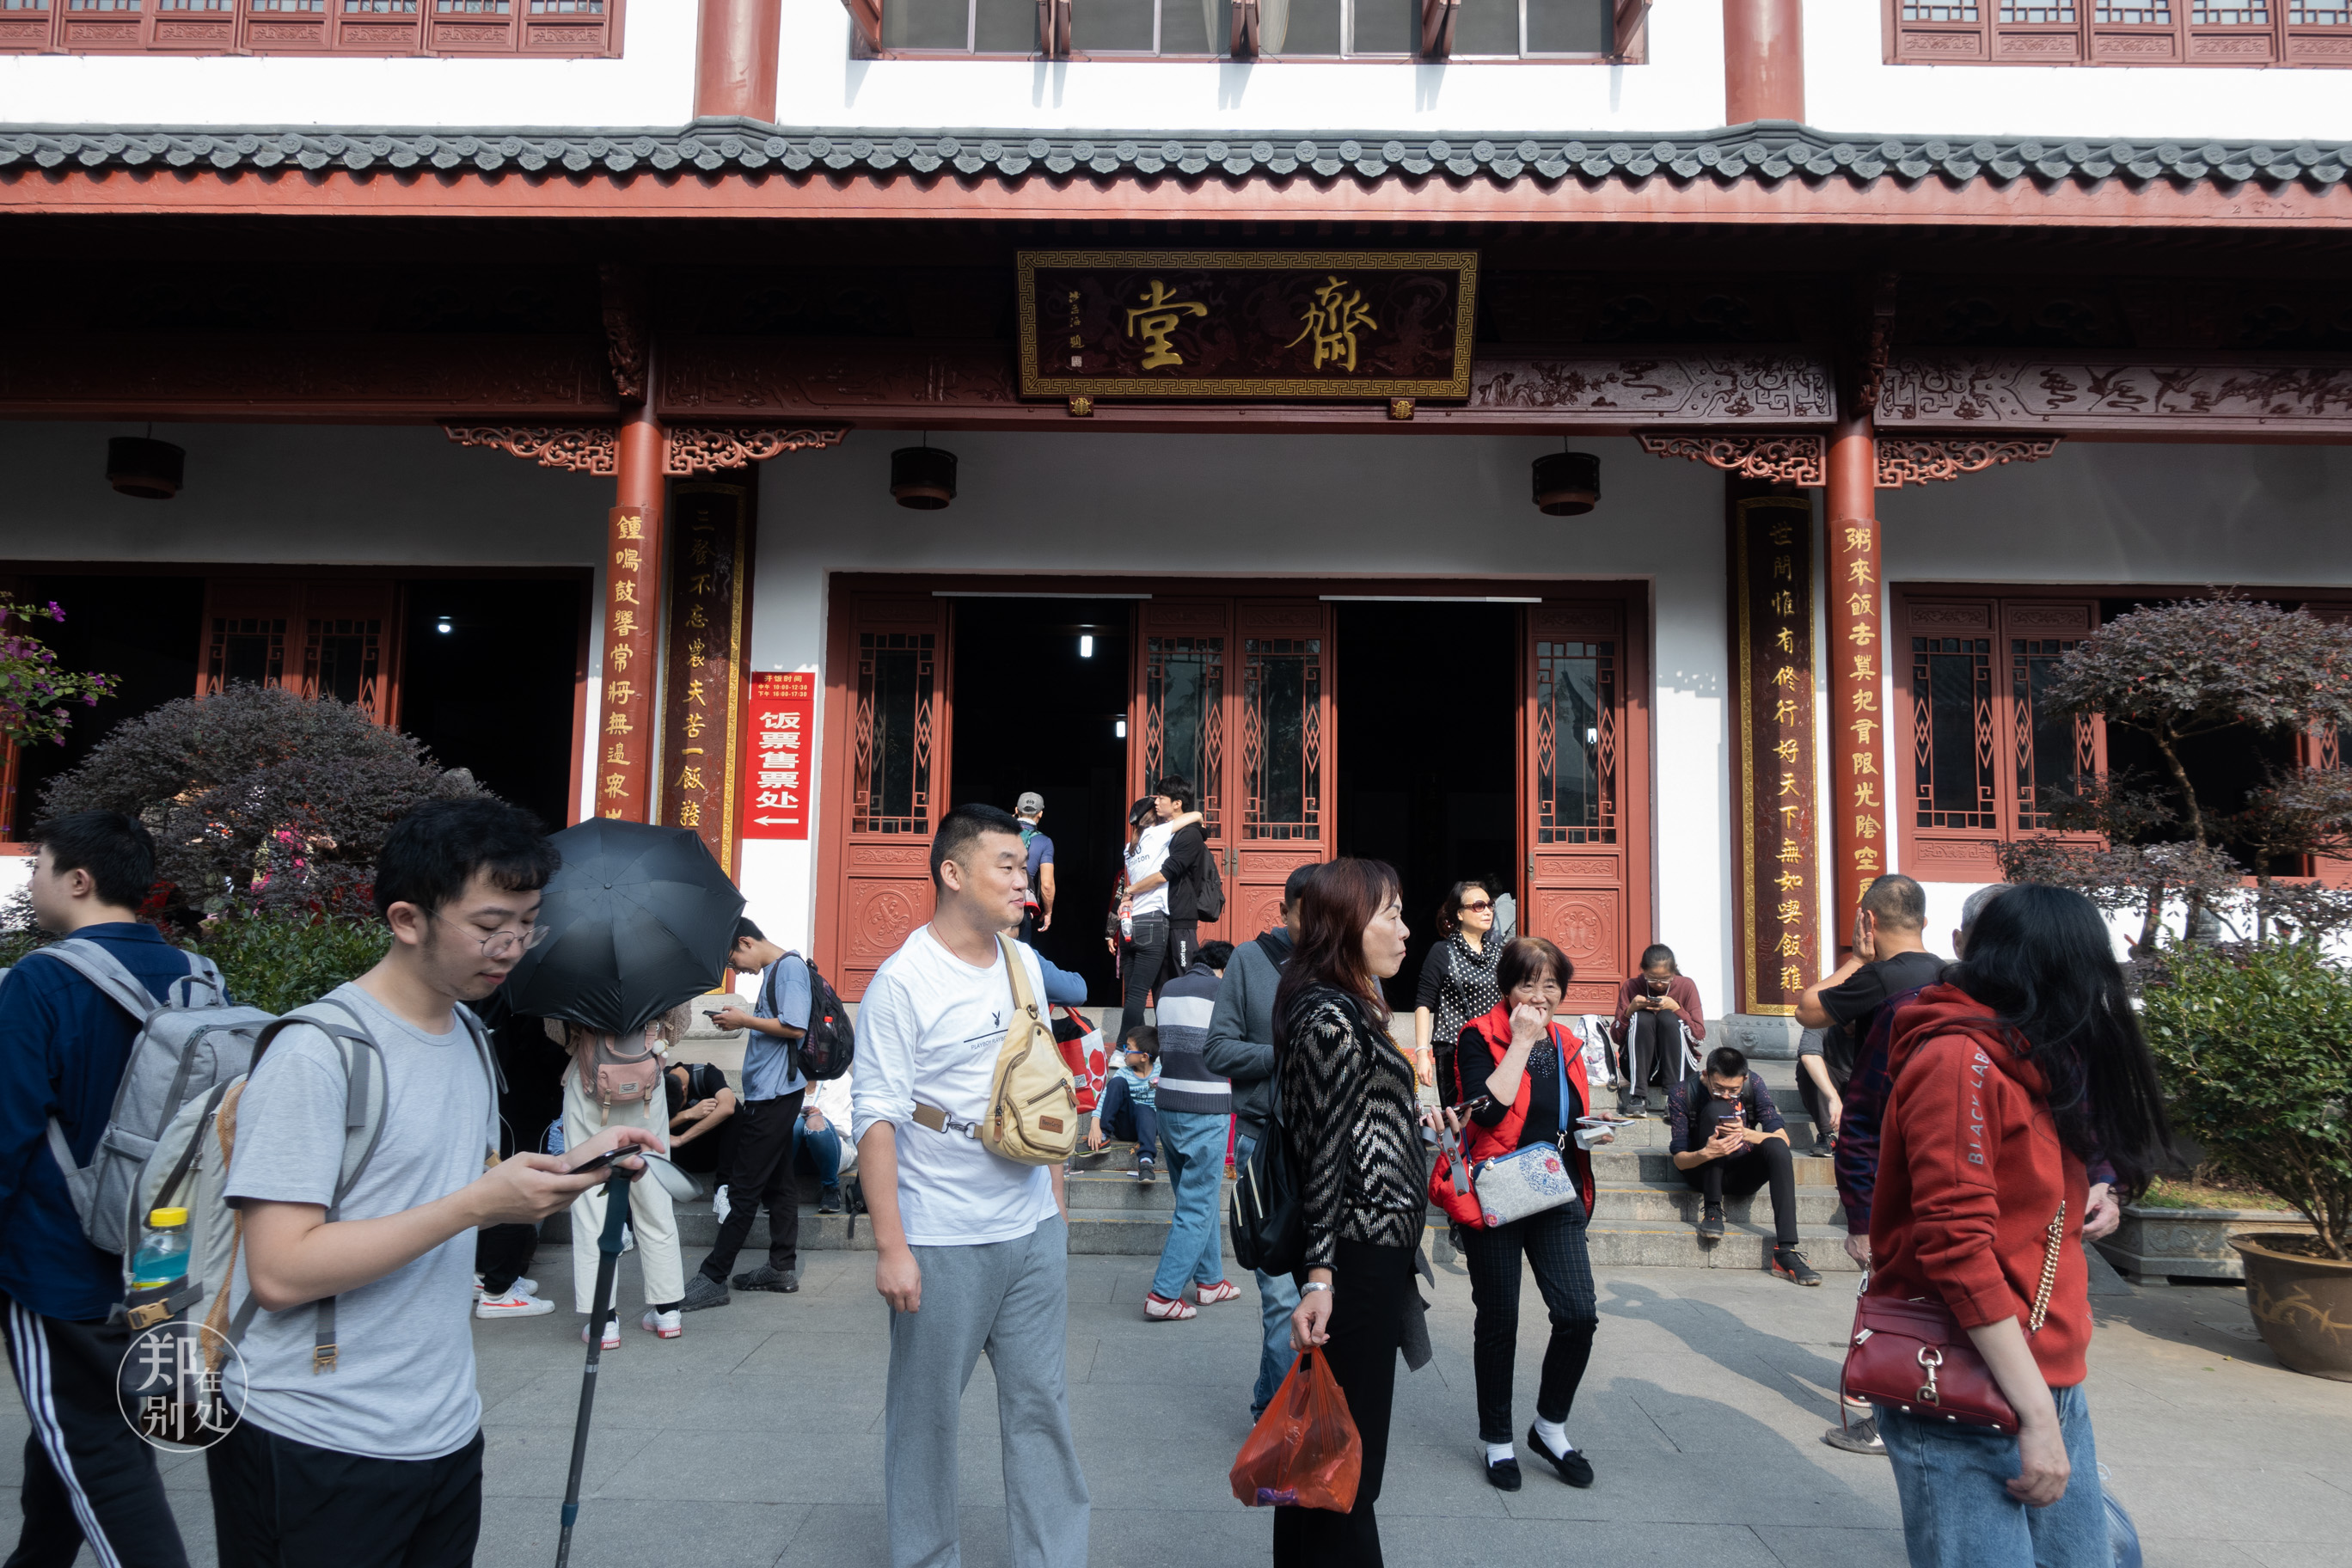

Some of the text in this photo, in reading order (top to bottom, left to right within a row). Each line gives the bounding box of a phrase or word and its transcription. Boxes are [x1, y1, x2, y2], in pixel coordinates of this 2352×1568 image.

[756, 711, 801, 809] 饭票售票处
[971, 1039, 991, 1050] PLAYBOY
[1968, 1046, 1990, 1165] BLACK LAB
